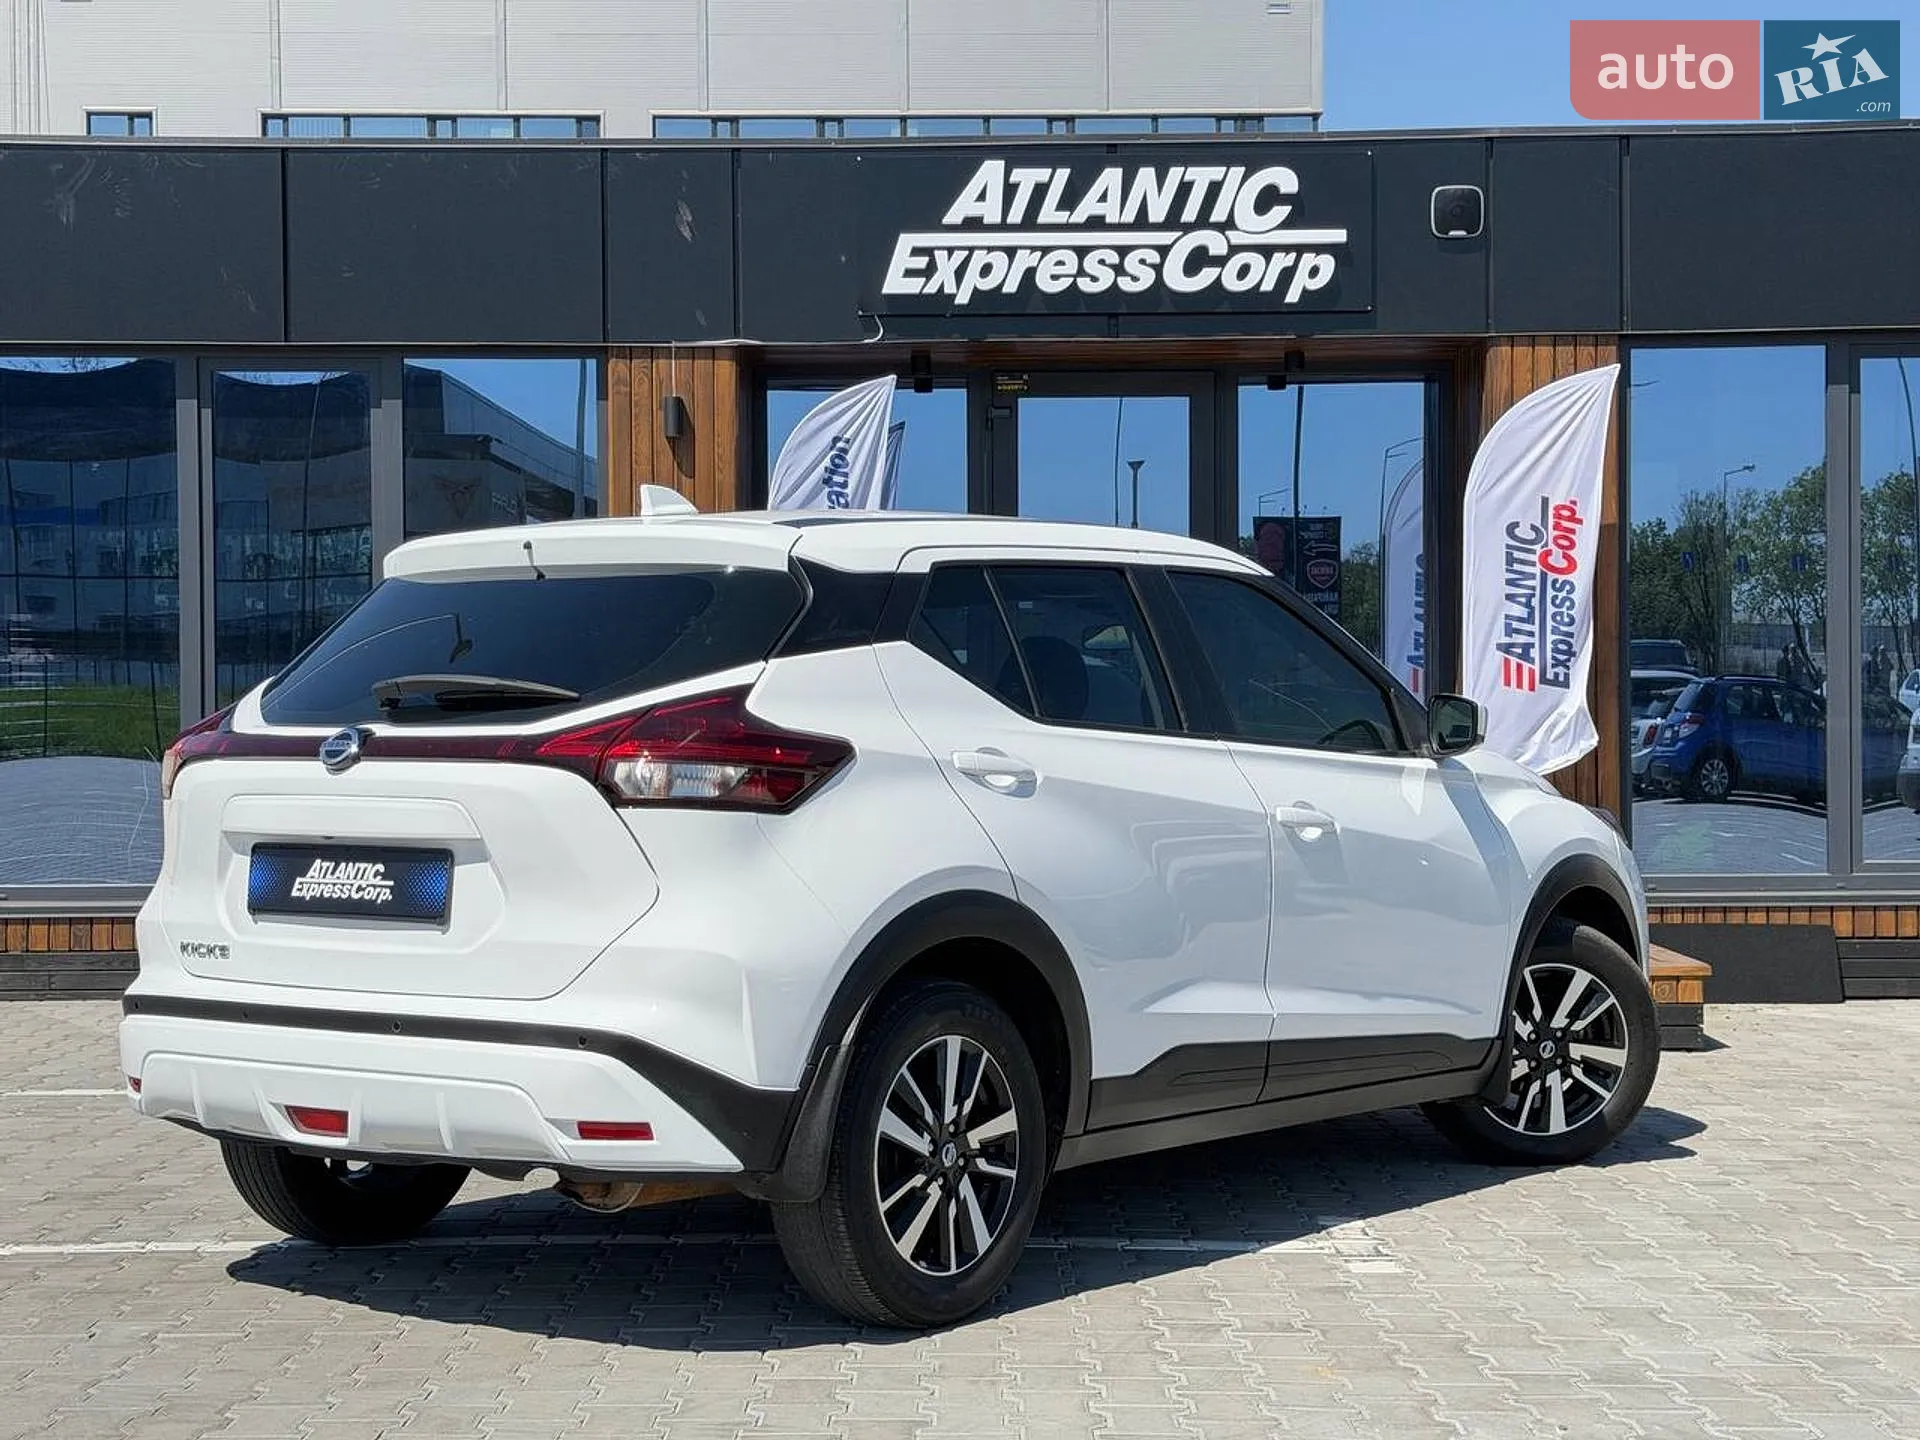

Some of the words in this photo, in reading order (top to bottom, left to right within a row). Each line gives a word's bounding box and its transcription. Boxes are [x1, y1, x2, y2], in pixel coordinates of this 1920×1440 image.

[942, 160, 1299, 232] ATLANTIC
[822, 435, 850, 509] ation
[1497, 521, 1545, 666] ATLANTIC
[306, 859, 385, 881] ATLANTIC
